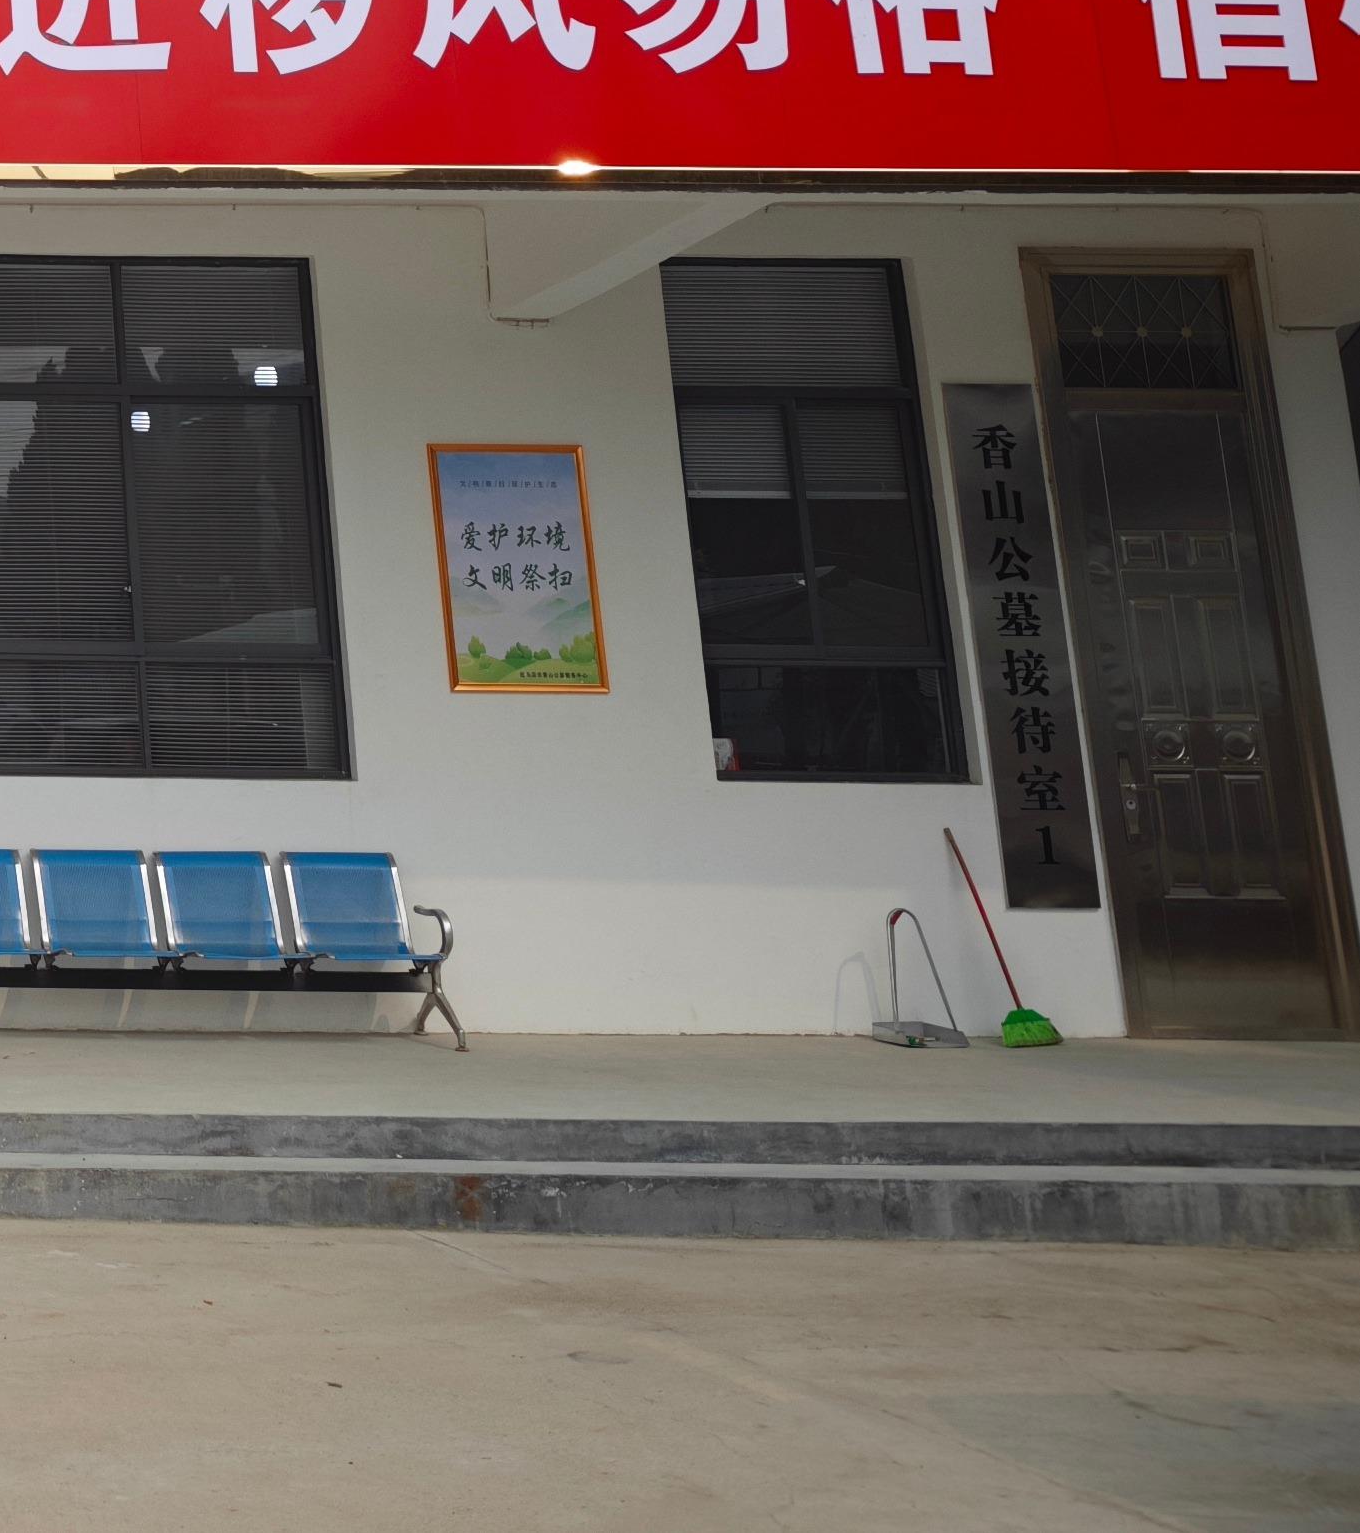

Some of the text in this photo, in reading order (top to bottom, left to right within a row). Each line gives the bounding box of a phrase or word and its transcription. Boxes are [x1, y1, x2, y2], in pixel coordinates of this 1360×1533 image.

[460, 521, 571, 552] 爱护环境
[462, 563, 573, 591] 文明祭扫
[971, 423, 1065, 866] 香山公墓接待室1
